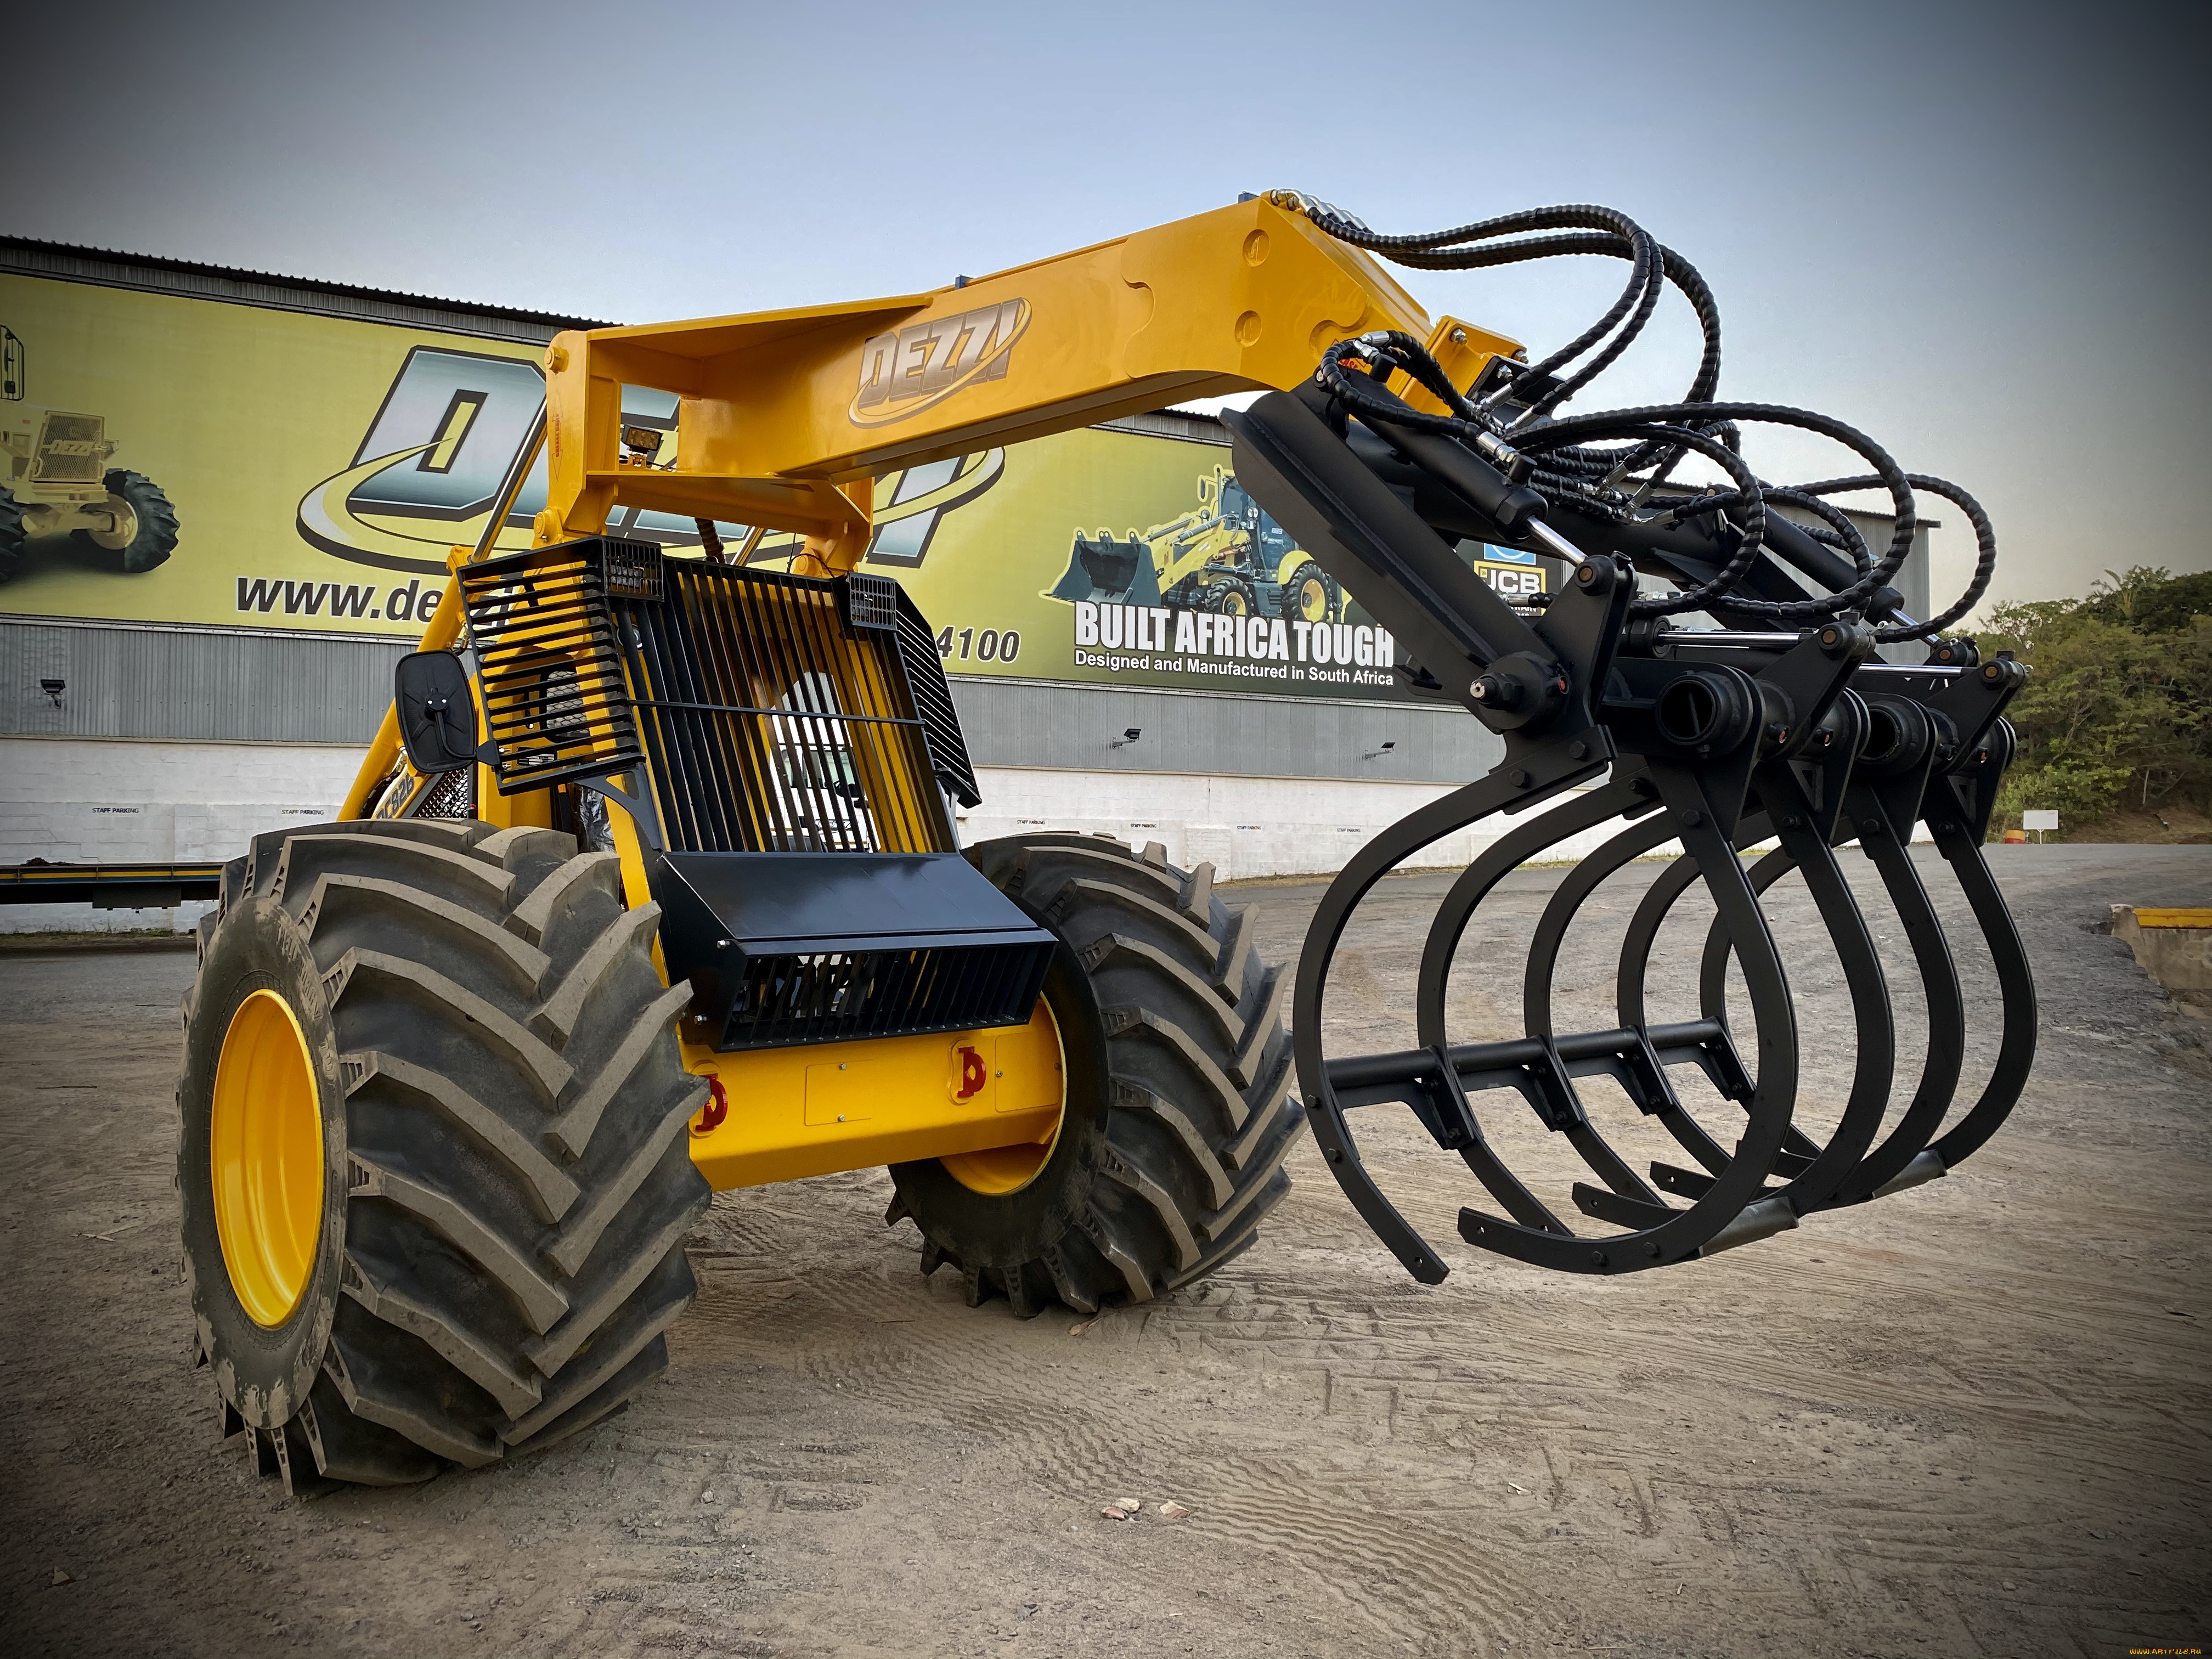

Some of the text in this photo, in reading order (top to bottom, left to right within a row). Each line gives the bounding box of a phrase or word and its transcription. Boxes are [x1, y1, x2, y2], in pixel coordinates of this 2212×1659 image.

[856, 297, 1024, 409] DEZZI
[1487, 569, 1540, 593] JCB
[936, 626, 1020, 662] 4100
[1075, 601, 1394, 668] BUILT AFRICA TOUGH
[1075, 650, 1393, 685] Designed and Manufactured in South Africa
